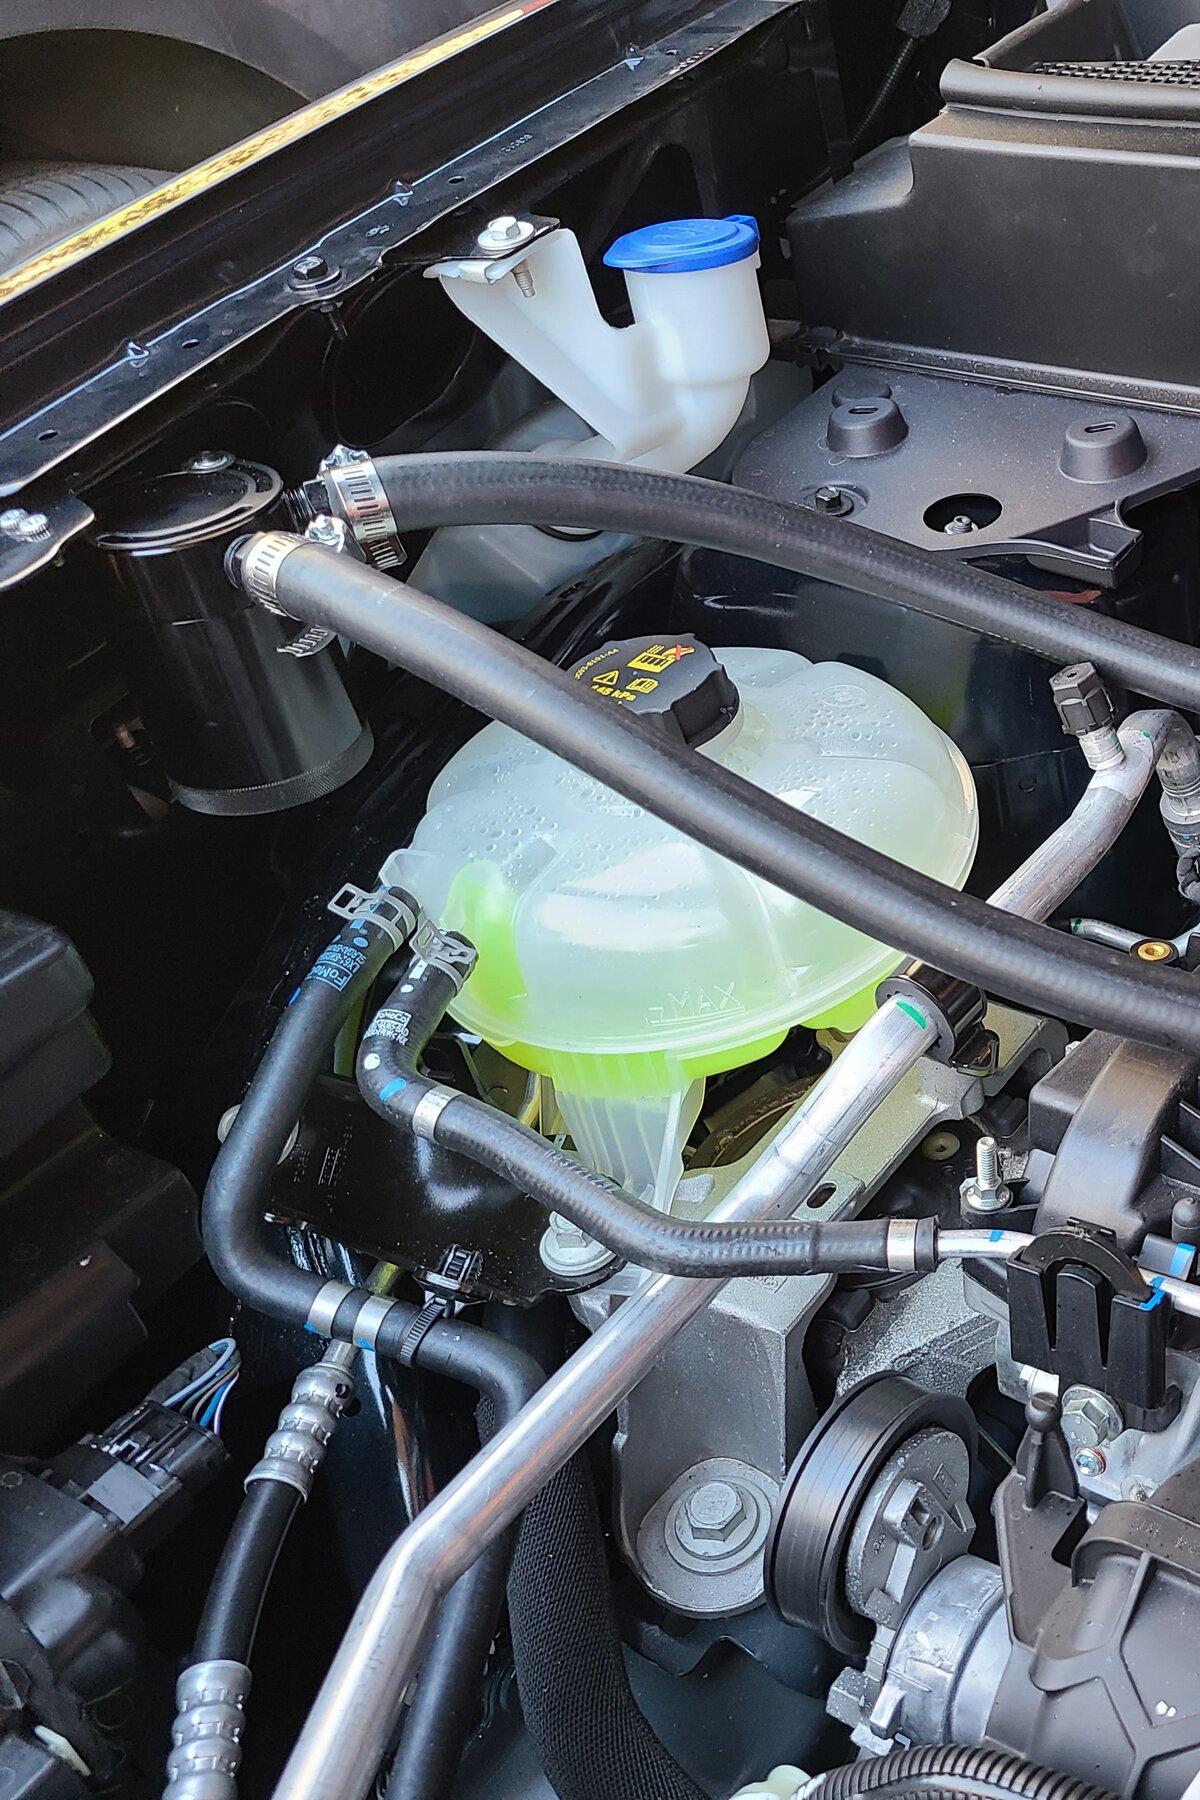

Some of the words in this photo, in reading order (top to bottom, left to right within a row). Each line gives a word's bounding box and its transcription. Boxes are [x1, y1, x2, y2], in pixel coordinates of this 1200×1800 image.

[611, 689, 637, 702] kPa
[312, 964, 348, 987] FoMo
[667, 981, 741, 1018] MAX
